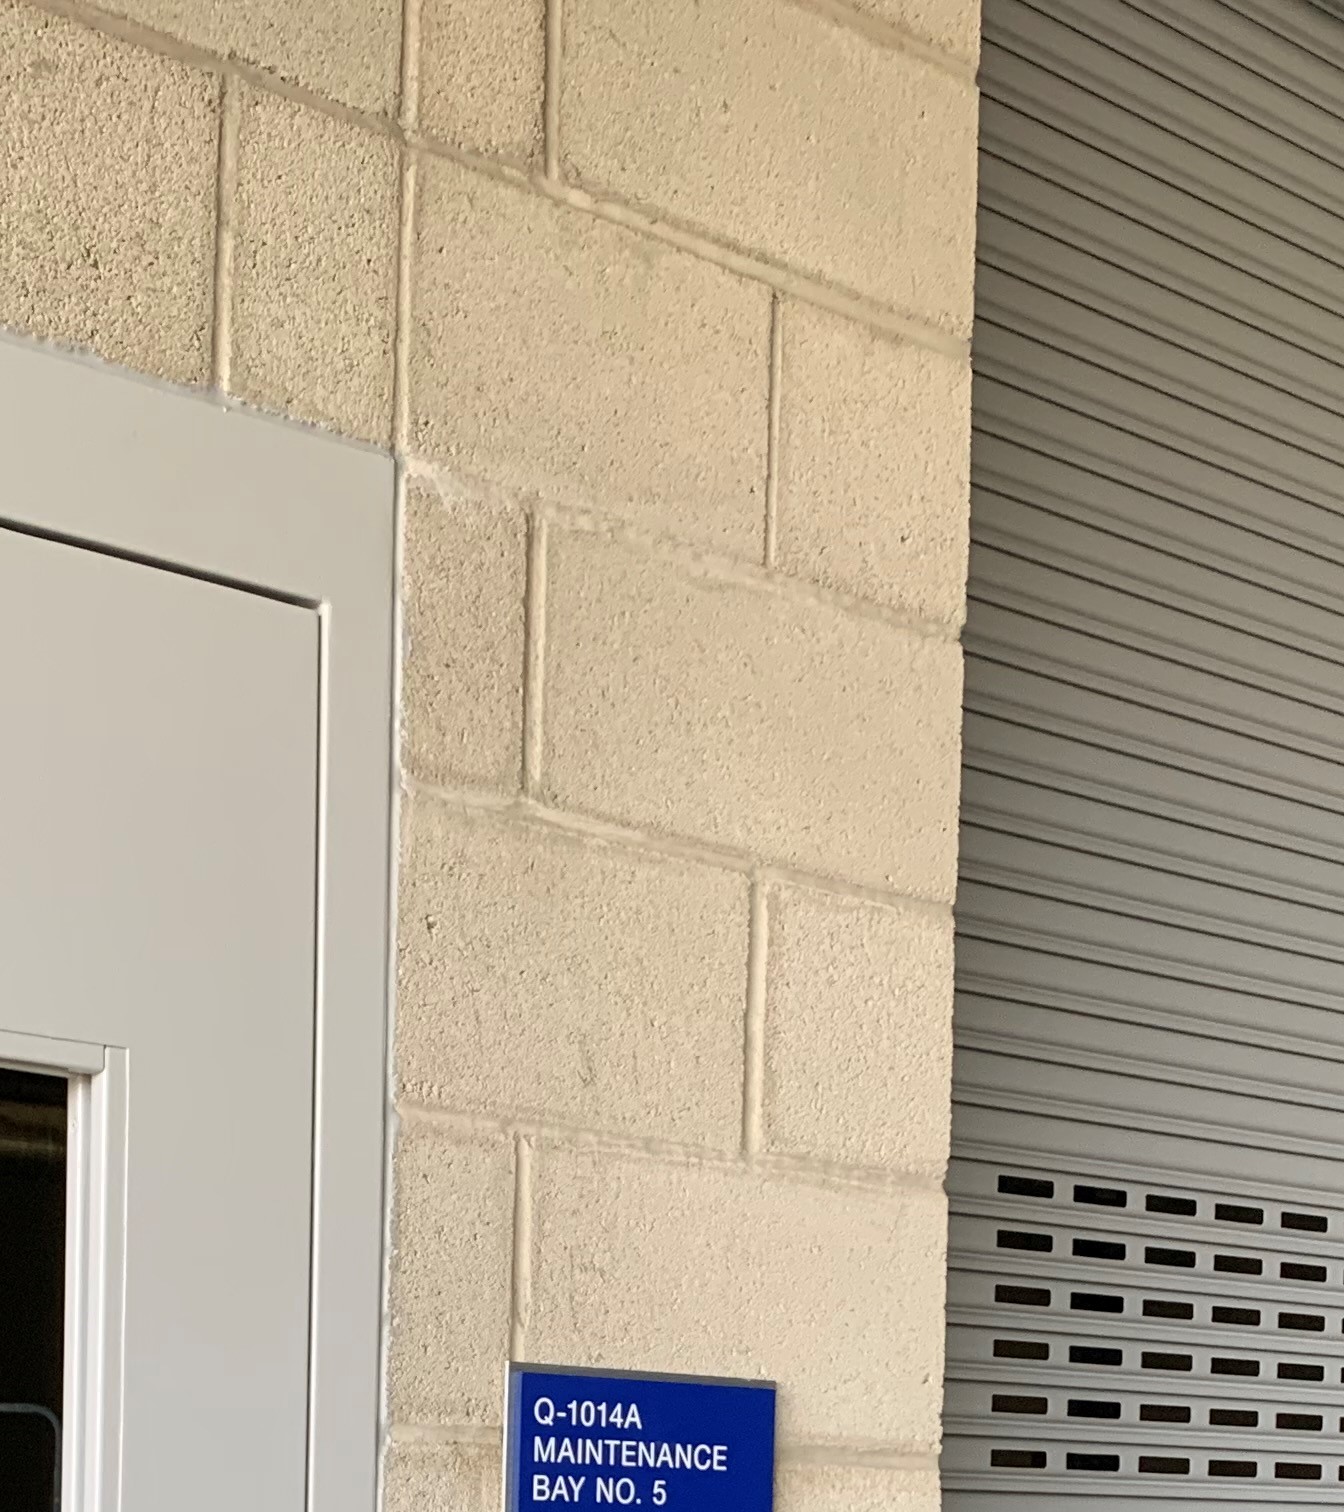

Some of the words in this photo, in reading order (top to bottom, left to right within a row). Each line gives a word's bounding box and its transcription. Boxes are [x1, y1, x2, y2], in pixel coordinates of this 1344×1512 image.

[533, 1397, 643, 1429] Q-1014A
[533, 1436, 728, 1471] MAINTENANCE
[532, 1474, 586, 1502] BAY
[595, 1477, 642, 1505] NO.
[652, 1480, 668, 1505] 5
